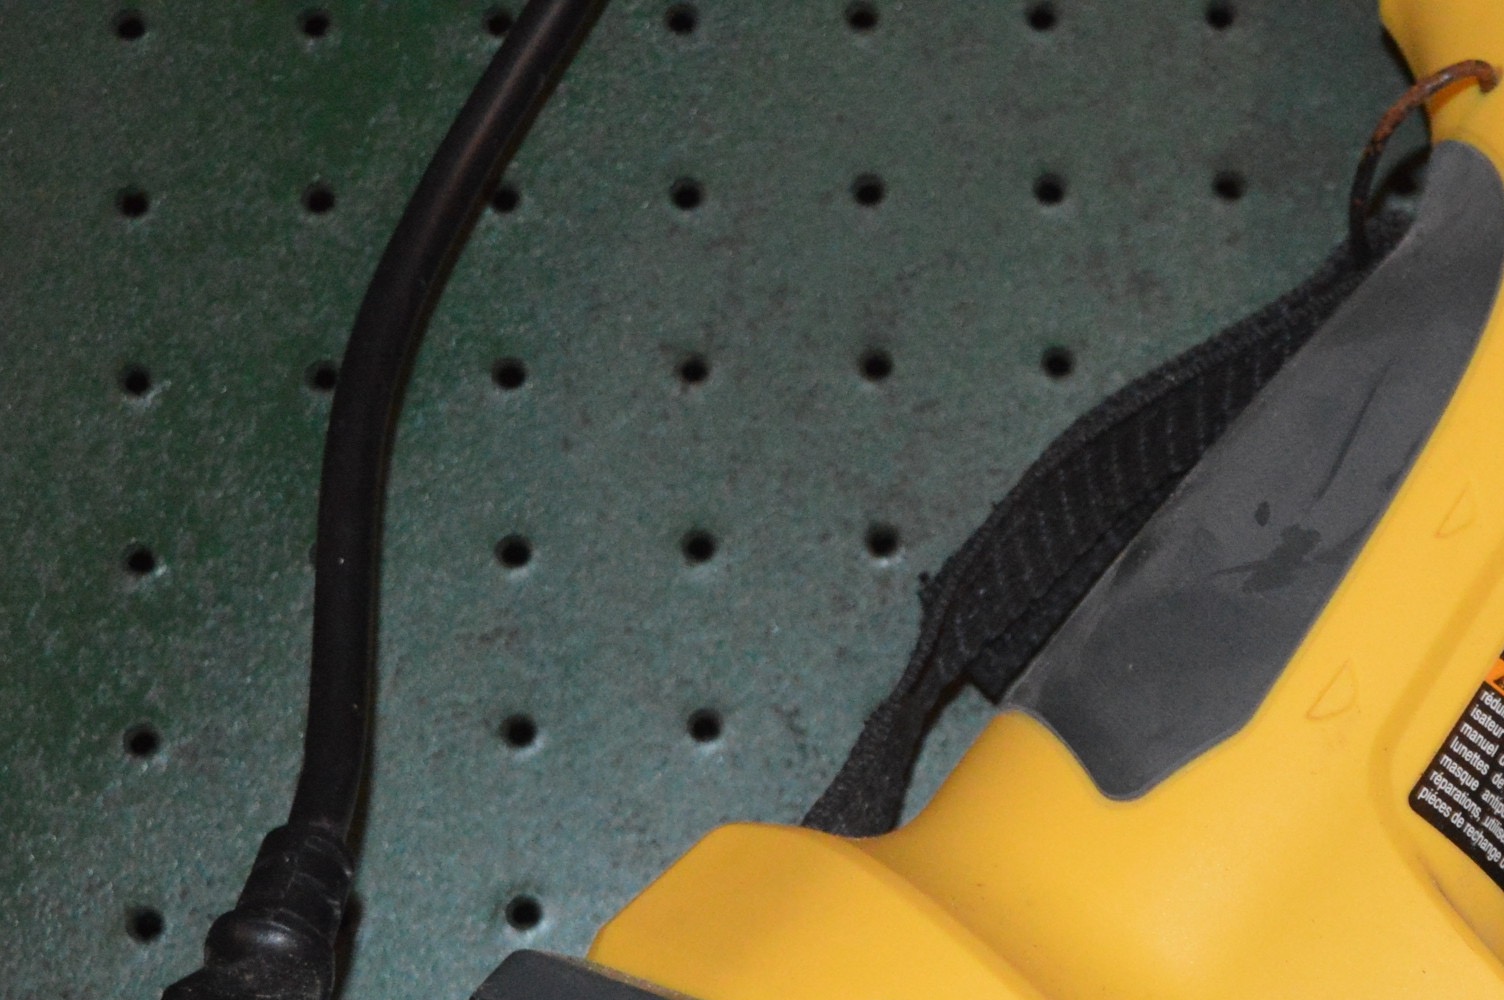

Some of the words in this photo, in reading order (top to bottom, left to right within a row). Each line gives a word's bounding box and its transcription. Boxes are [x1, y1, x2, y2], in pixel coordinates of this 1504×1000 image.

[1450, 736, 1490, 775] lunettes
[1491, 772, 1504, 790] de
[1460, 722, 1499, 757] manuel
[1429, 770, 1482, 821] réparations,
[1439, 754, 1480, 791] masque
[1450, 811, 1465, 829] de
[1463, 822, 1502, 863] rechange
